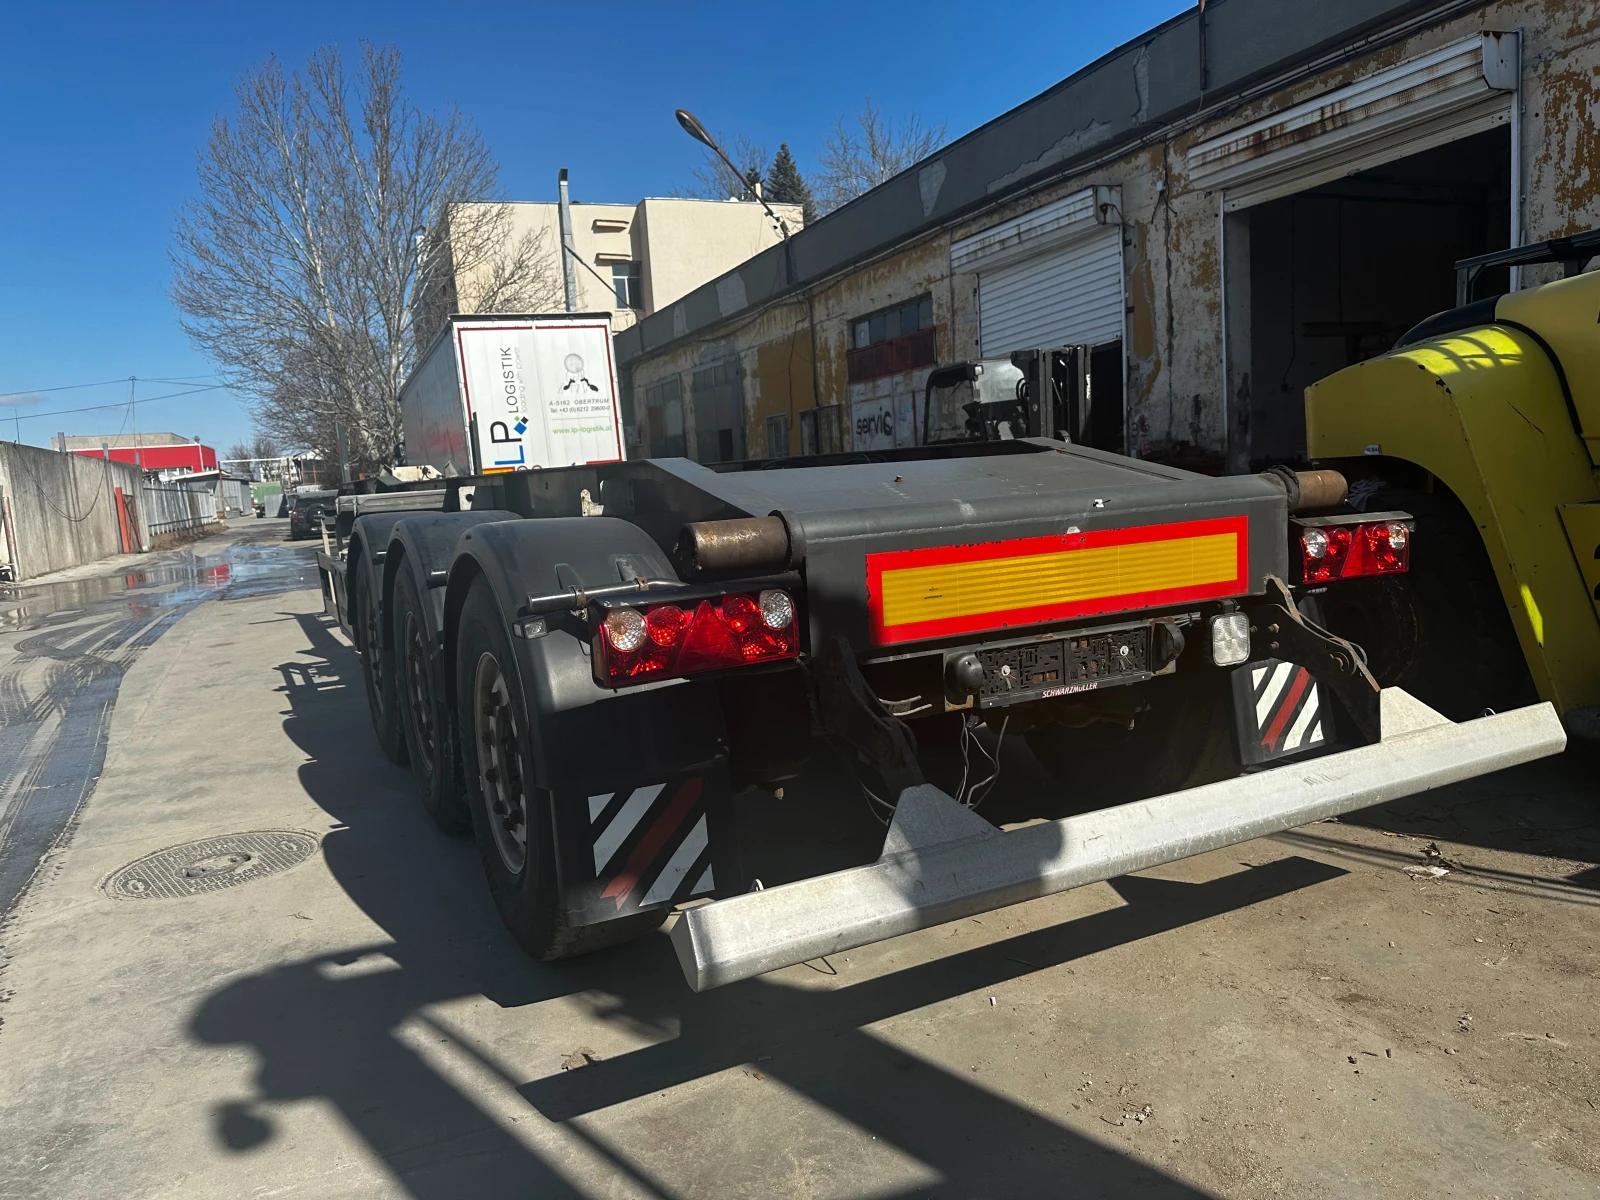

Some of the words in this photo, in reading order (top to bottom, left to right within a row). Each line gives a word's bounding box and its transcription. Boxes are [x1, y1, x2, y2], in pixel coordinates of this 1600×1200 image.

[500, 347, 519, 413] LOGISTIK
[519, 385, 527, 413] loading
[490, 421, 525, 465] LP
[553, 425, 612, 434] www.lp-logistik.at
